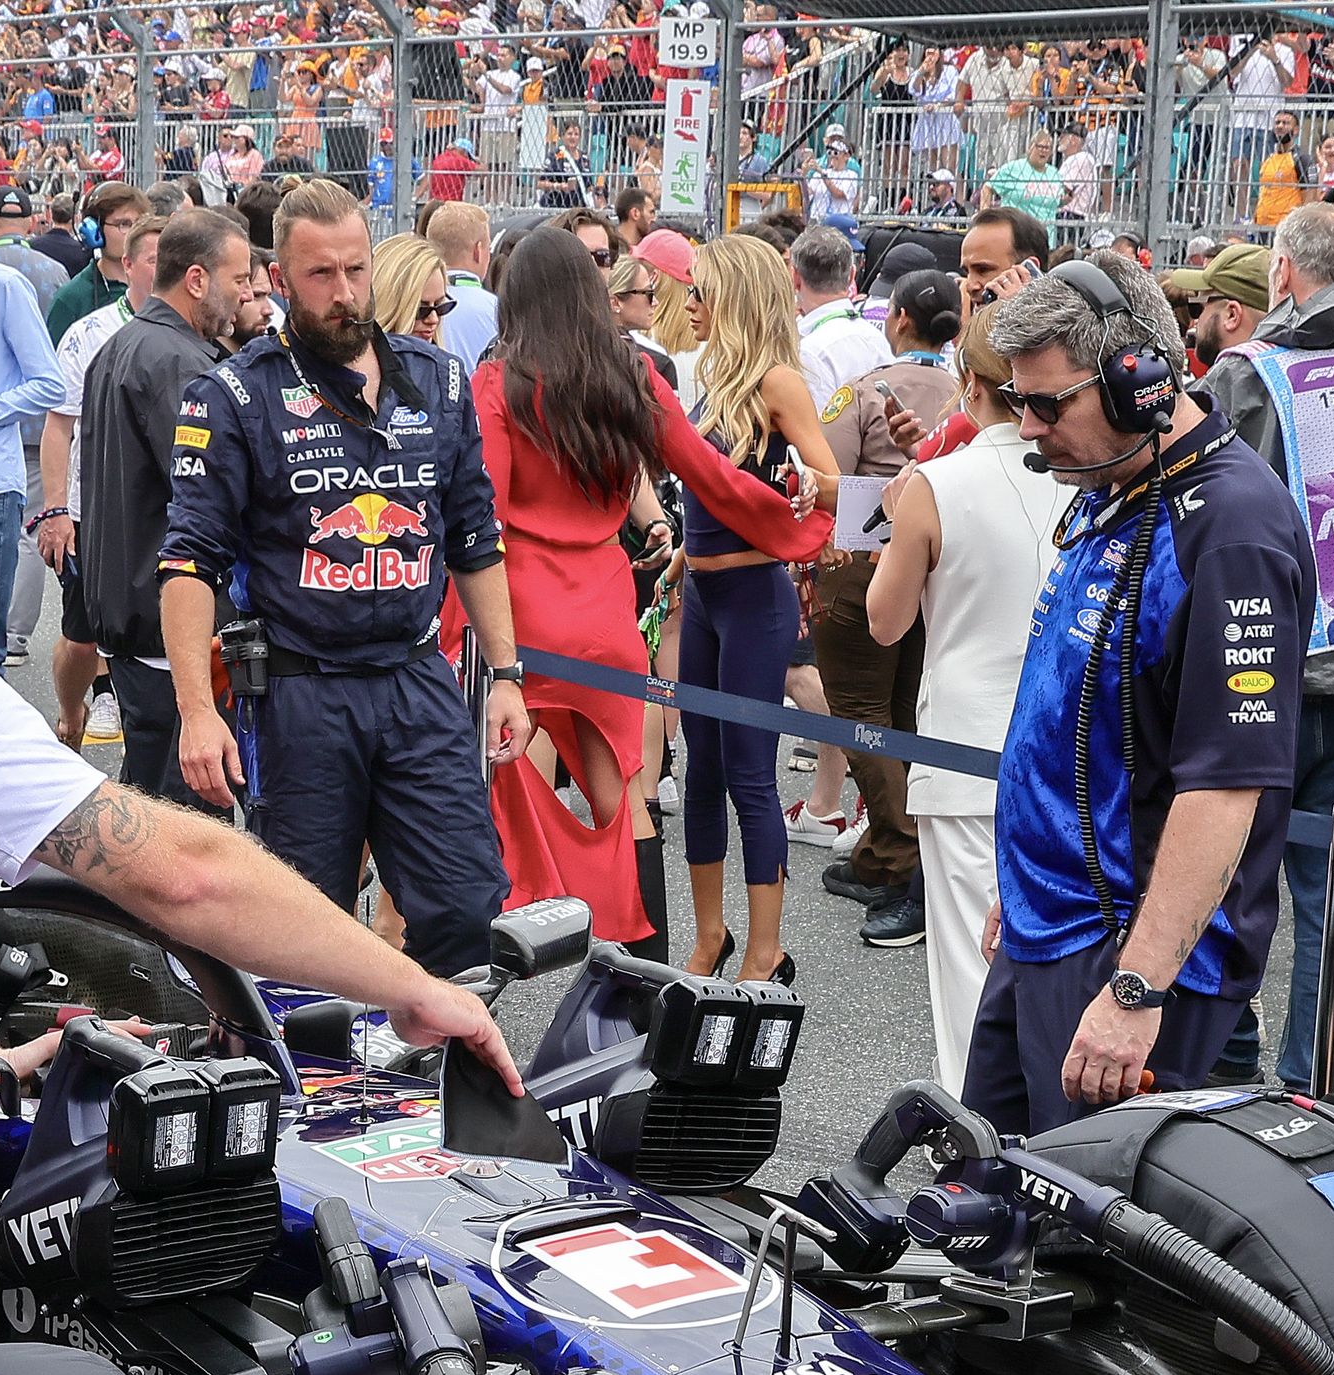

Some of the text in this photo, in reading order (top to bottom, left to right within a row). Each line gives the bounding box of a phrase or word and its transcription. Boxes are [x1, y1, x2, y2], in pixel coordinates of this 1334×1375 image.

[673, 22, 705, 39] MP
[668, 44, 709, 61] 19.9
[674, 119, 700, 129] FIRE
[670, 182, 698, 193] EXIT
[217, 366, 251, 406] sparco
[448, 358, 460, 403] sparco
[1134, 376, 1173, 398] ORACLE
[180, 400, 208, 419] Mobil
[390, 406, 421, 424] Ford
[282, 424, 325, 444] Mobil
[287, 447, 345, 464] CARLYLE
[290, 463, 437, 494] ORACLE
[299, 543, 435, 591] Red Bull
[1223, 597, 1273, 617] VISA
[1244, 623, 1275, 639] AT&T
[1224, 646, 1276, 666] ROKT
[646, 676, 676, 690] ORACLE
[1240, 675, 1271, 688] RAUCH
[1239, 699, 1268, 711] AVA
[1228, 710, 1277, 724] TRADE
[1019, 1168, 1074, 1212] YETI
[947, 1236, 991, 1249] YETI
